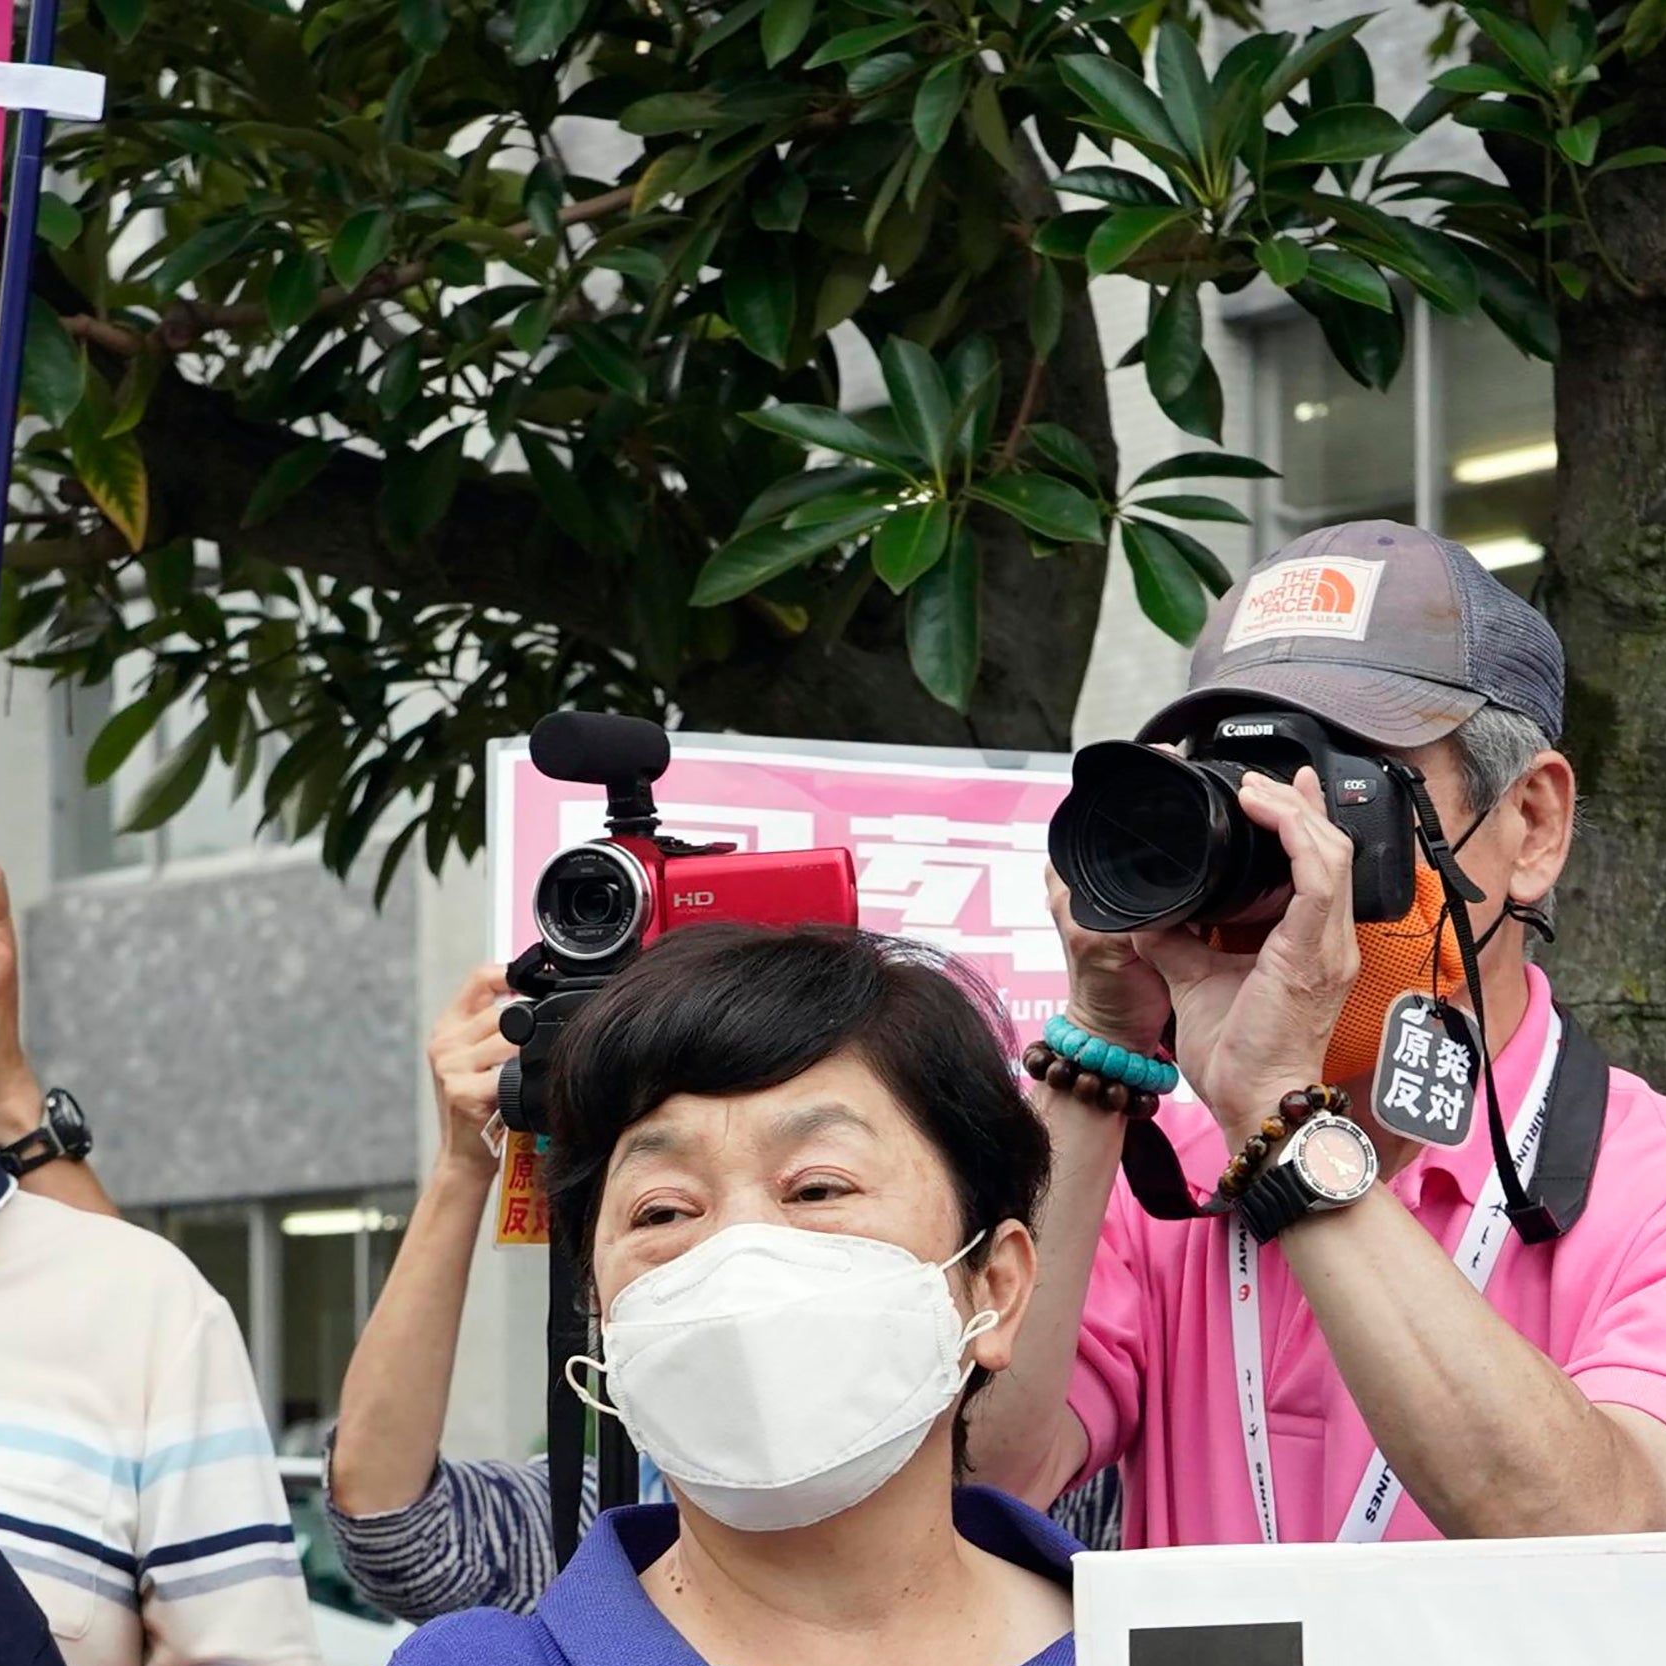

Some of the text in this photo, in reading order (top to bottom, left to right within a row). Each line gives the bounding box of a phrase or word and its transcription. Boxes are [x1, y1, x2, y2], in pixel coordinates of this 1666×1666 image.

[1281, 567, 1319, 586] THE
[1247, 582, 1315, 611] NORTH
[1260, 596, 1312, 617] FACE
[1222, 723, 1275, 737] Canon
[1344, 780, 1367, 790] EOS
[559, 799, 1069, 973] 葬
[673, 891, 715, 908] HD
[1392, 1022, 1472, 1085] 原発
[1383, 1067, 1465, 1131] 反対
